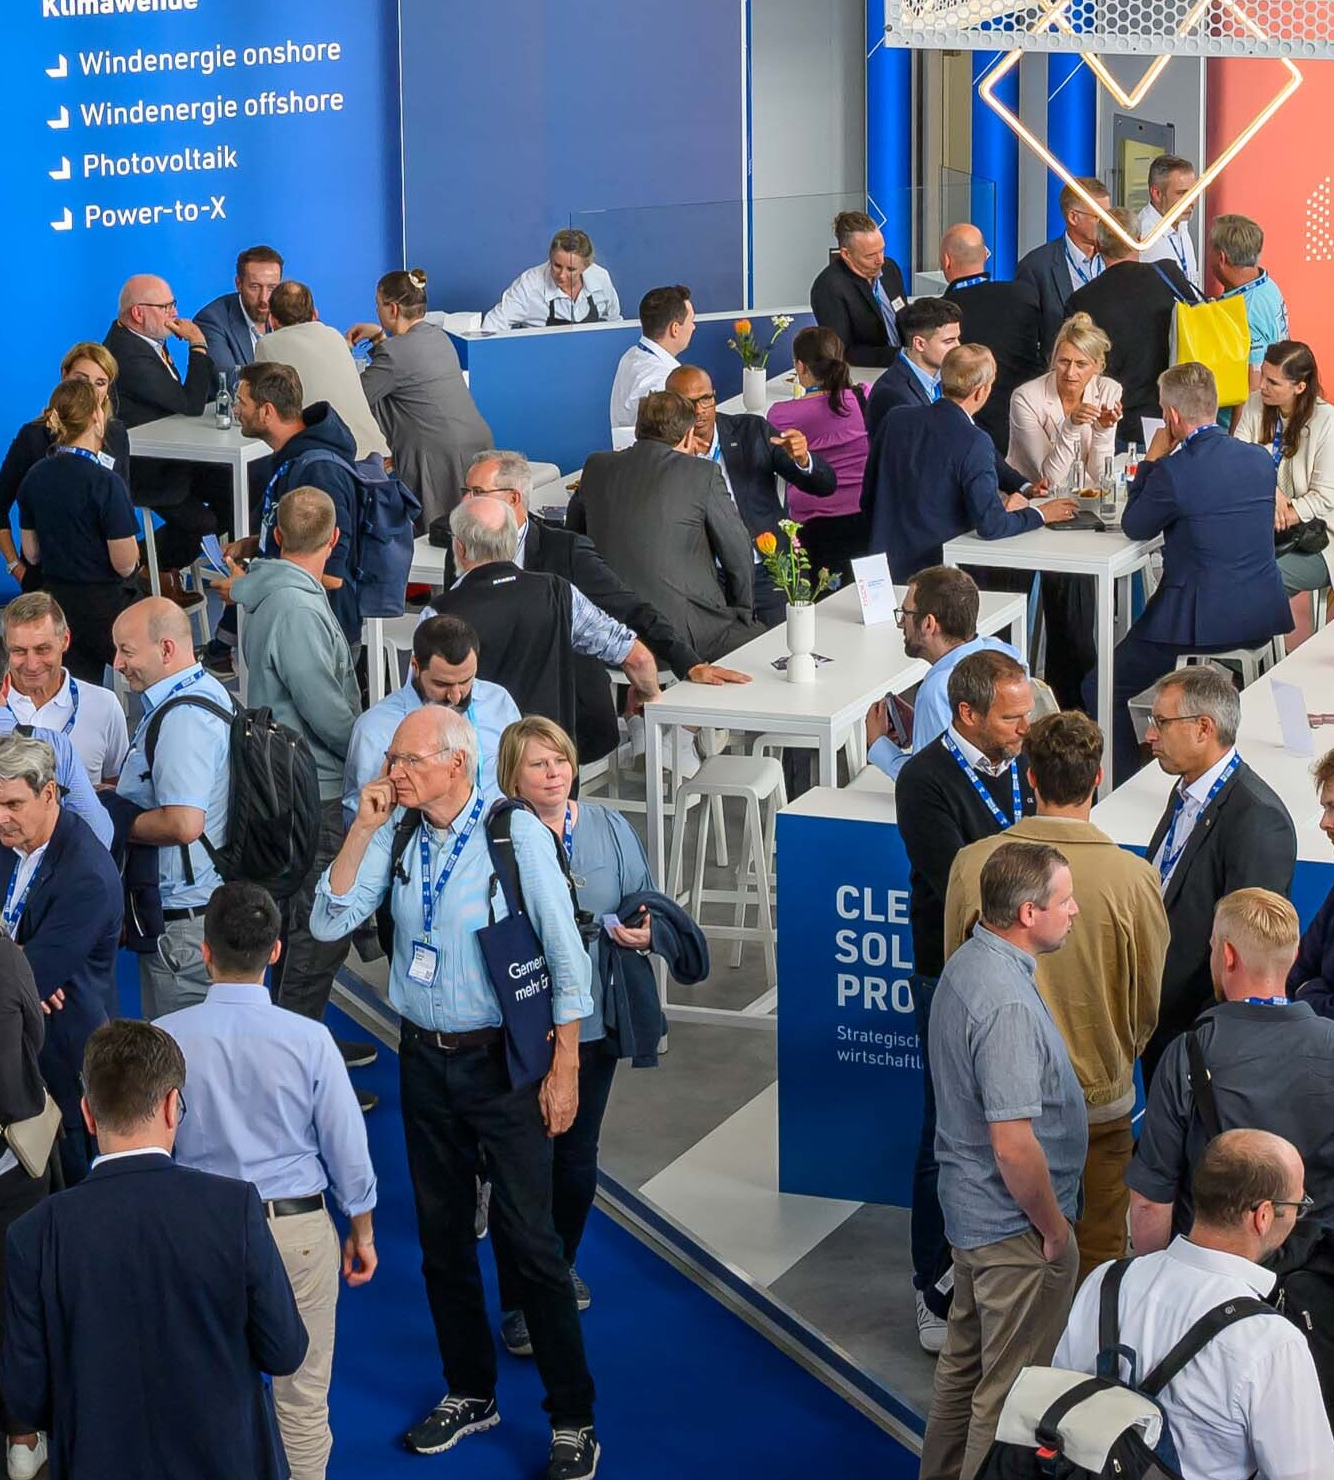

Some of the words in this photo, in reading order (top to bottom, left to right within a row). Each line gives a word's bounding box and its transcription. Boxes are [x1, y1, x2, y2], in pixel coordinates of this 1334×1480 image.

[79, 45, 236, 76] Windenergie
[243, 40, 341, 66] onshore
[80, 95, 238, 126] Windenergie
[244, 91, 345, 116] offshore
[83, 146, 238, 178] Photovoltaik
[85, 196, 227, 228] Power-to-X
[836, 884, 909, 925] CLE
[835, 929, 913, 970] SOL
[515, 979, 540, 1002] mehr
[837, 973, 915, 1014] PRO
[837, 1050, 924, 1070] wirtschaftl
